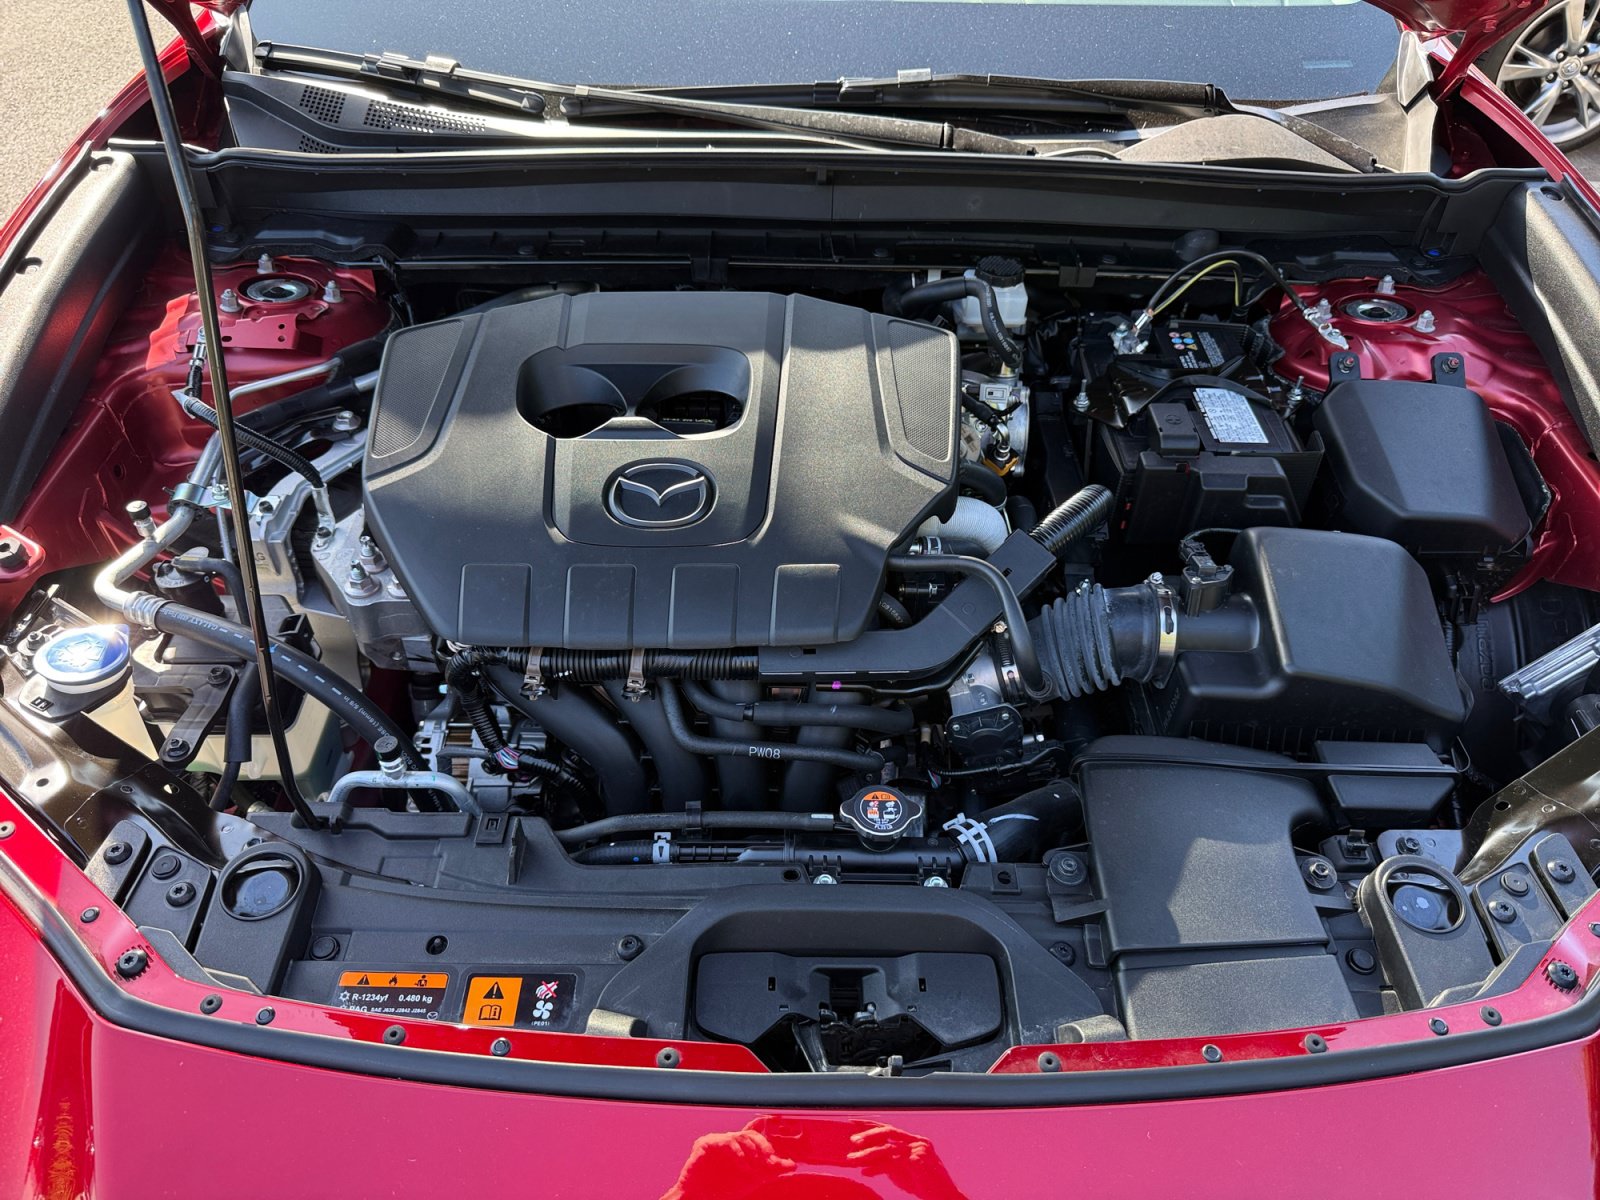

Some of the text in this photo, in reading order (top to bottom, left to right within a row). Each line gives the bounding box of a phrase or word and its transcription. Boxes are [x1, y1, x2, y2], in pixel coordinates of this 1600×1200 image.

[187, 617, 217, 630] GALAXY
[376, 725, 389, 738] OSE
[748, 746, 781, 759] PW08
[351, 993, 433, 1004] R-1234yf 0.480 kg
